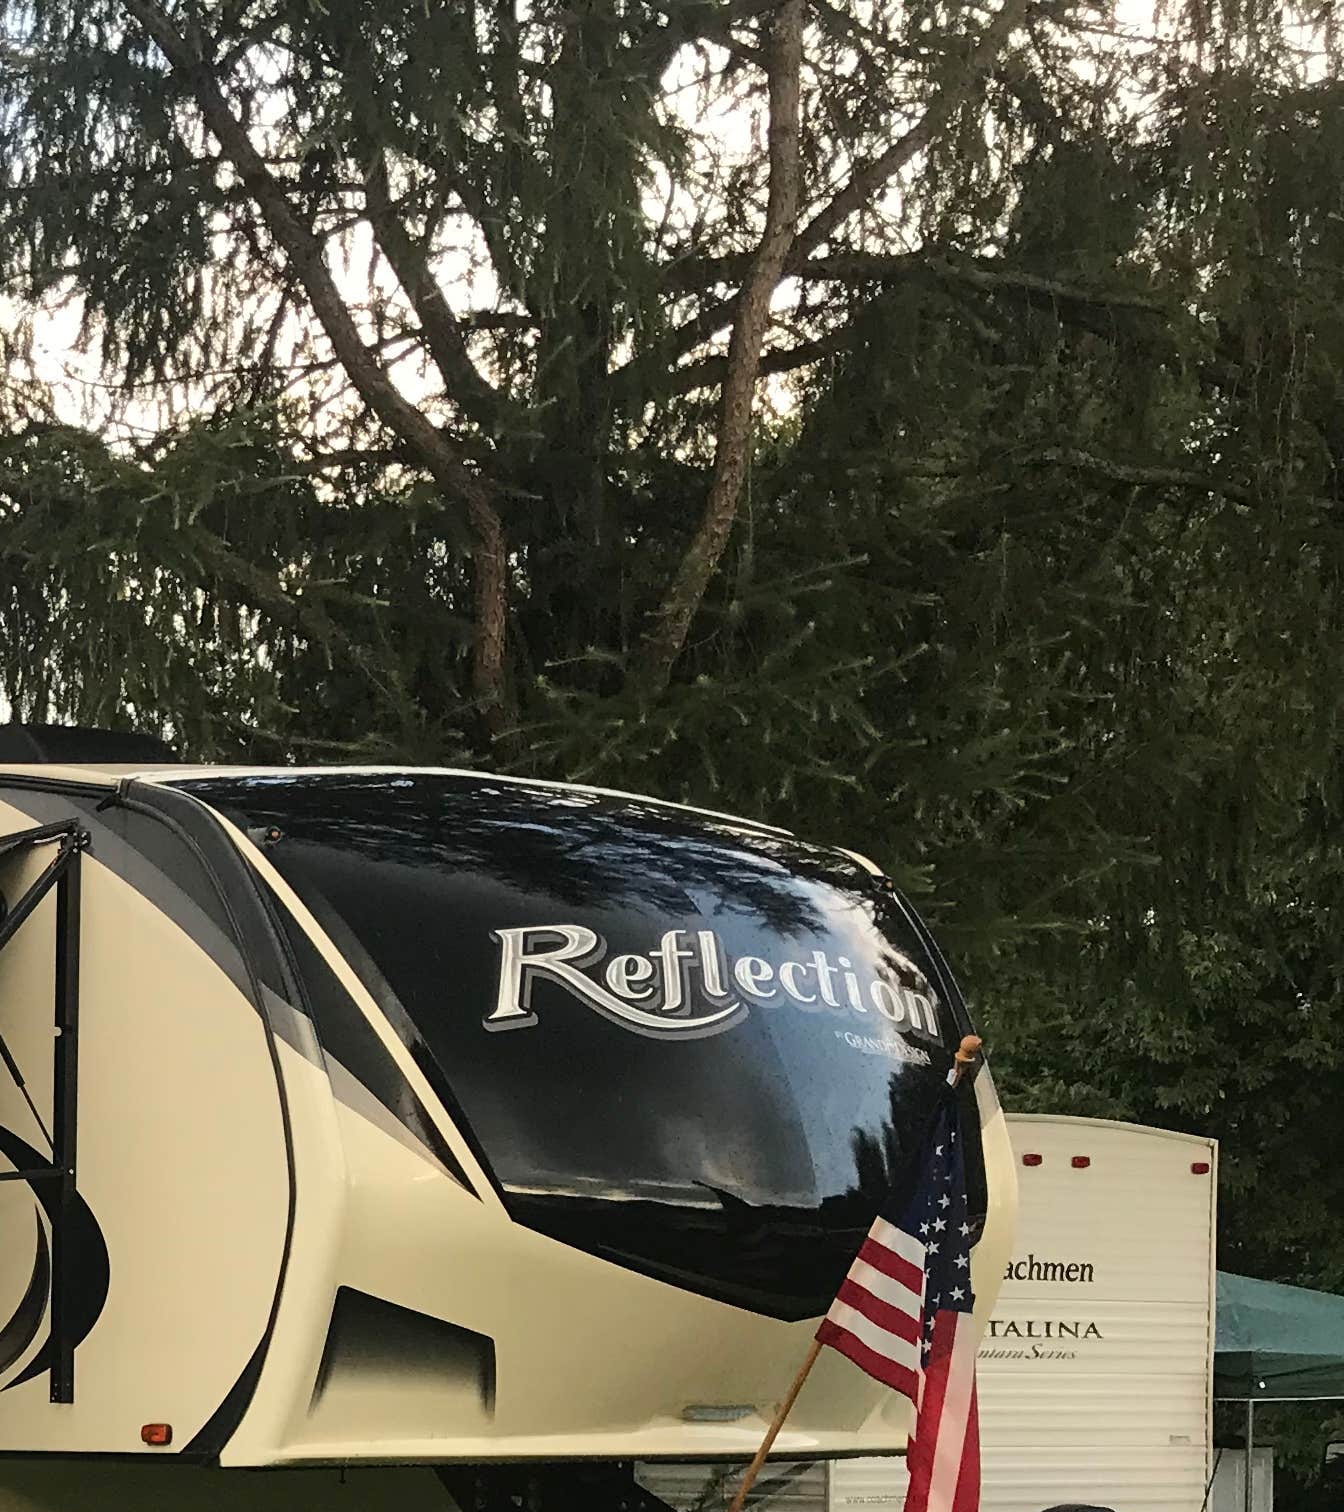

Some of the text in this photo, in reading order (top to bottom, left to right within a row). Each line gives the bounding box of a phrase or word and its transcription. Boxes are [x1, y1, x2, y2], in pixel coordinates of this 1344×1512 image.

[484, 924, 942, 1039] Reflection
[1003, 1254, 1094, 1283] achmen
[987, 1320, 1104, 1340] TALINA
